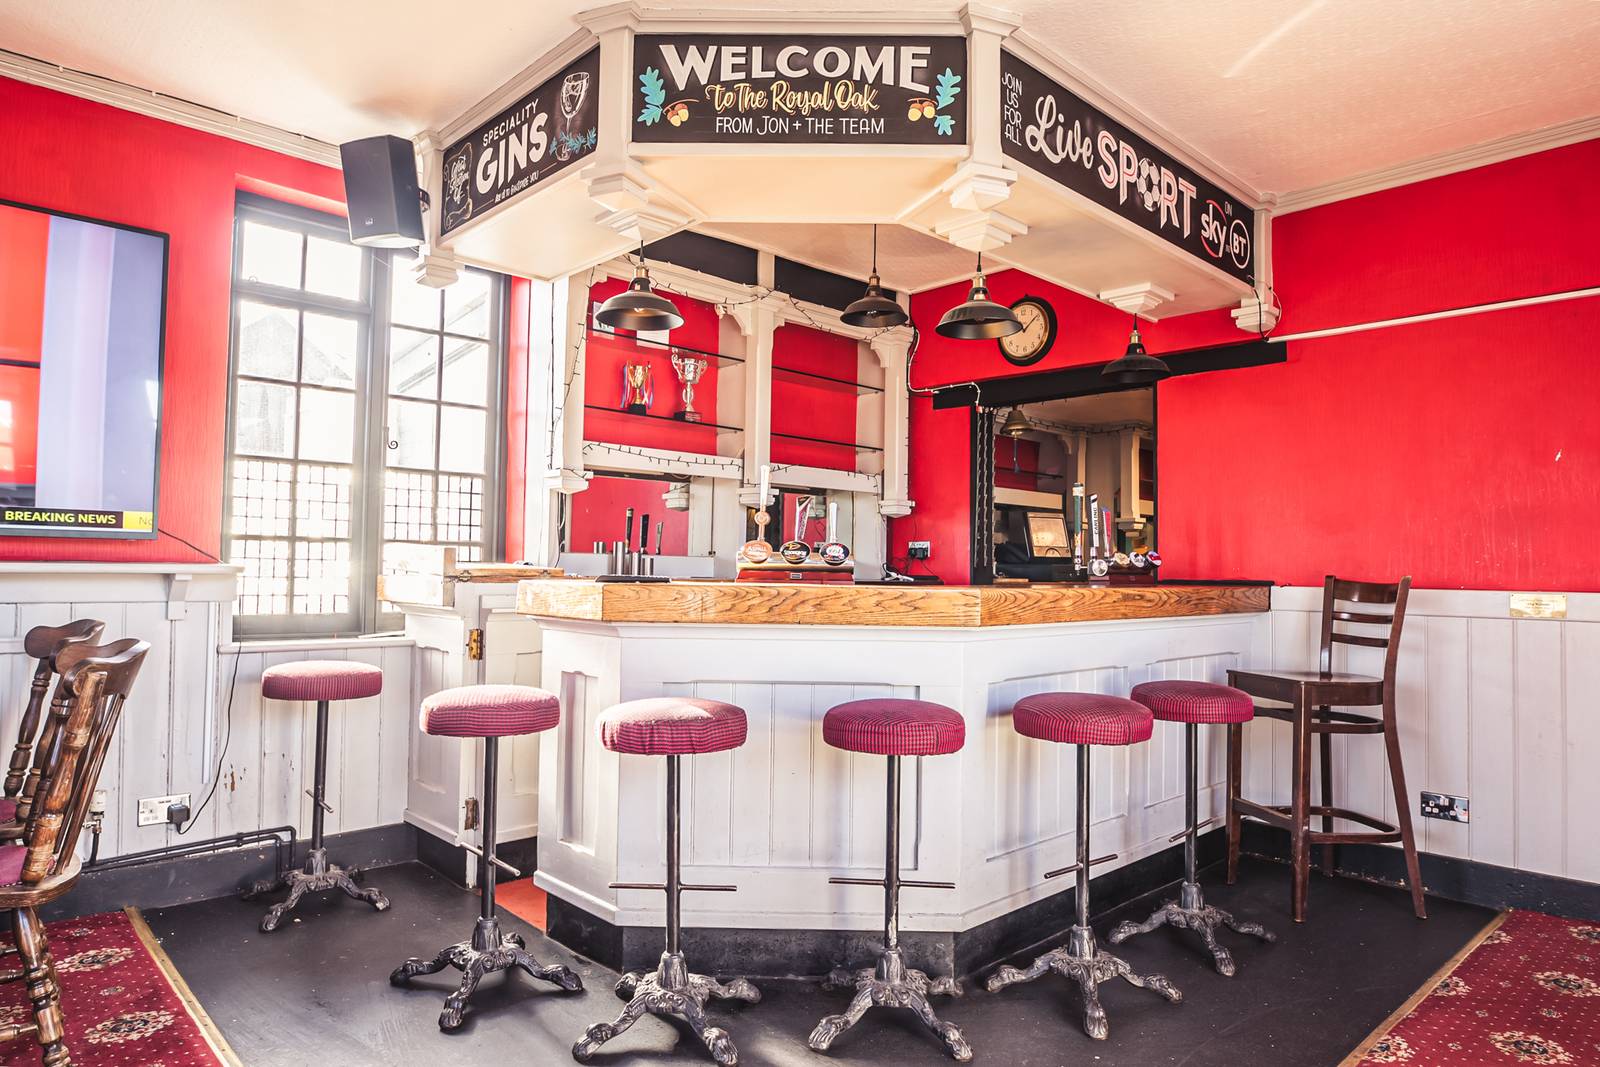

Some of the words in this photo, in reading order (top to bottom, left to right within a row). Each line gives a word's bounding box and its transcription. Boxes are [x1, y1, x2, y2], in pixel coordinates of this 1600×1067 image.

[659, 45, 931, 94] WELCOME
[1001, 72, 1022, 96] JOIN
[705, 84, 736, 114] to
[734, 83, 769, 113] The
[770, 80, 835, 116] Royal
[834, 80, 880, 114] Oak
[1006, 88, 1019, 108] US
[482, 98, 539, 147] SPECIALITY
[715, 117, 753, 134] FROM
[756, 116, 789, 135] JON
[792, 120, 802, 131] +
[805, 117, 834, 134] THE
[839, 118, 885, 134] TEAM
[1004, 104, 1022, 130] FOR
[1004, 124, 1022, 146] ALL
[1025, 94, 1094, 169] Live
[476, 112, 549, 194] GINS
[1224, 201, 1233, 217] ON
[1201, 204, 1228, 258] sky
[1233, 233, 1247, 257] BT
[4, 511, 75, 523] BREAKING
[78, 513, 117, 525] NEWS
